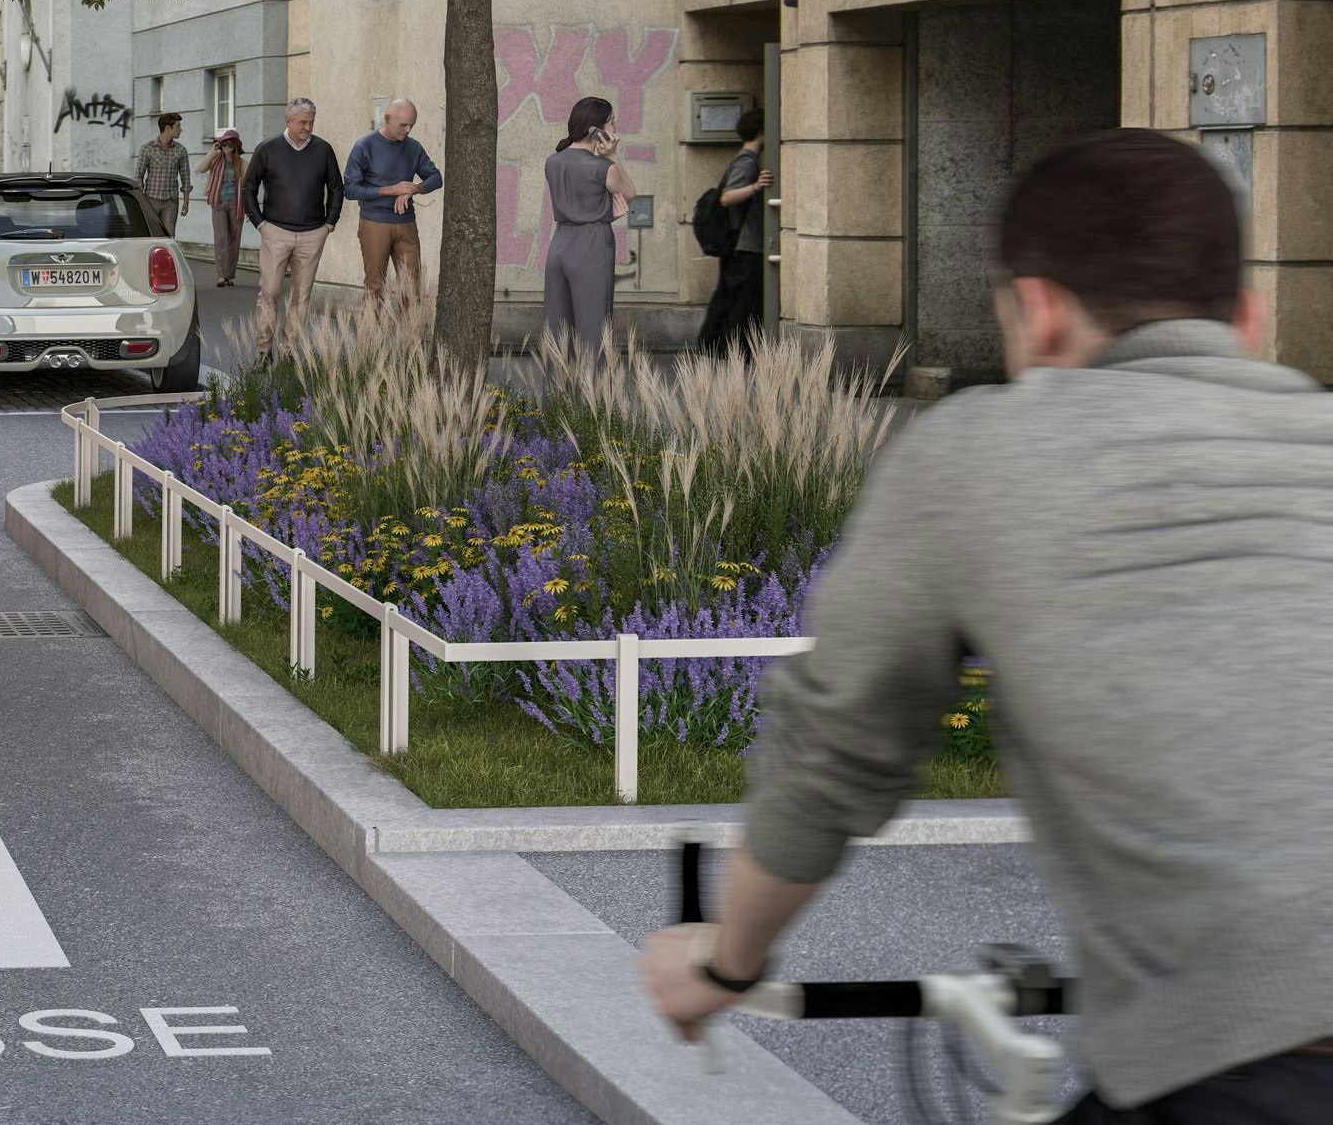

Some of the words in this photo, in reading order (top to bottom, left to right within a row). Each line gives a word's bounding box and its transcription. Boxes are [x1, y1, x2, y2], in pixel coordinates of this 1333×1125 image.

[31, 270, 41, 284] W
[50, 270, 90, 284] 54820
[92, 270, 101, 284] M
